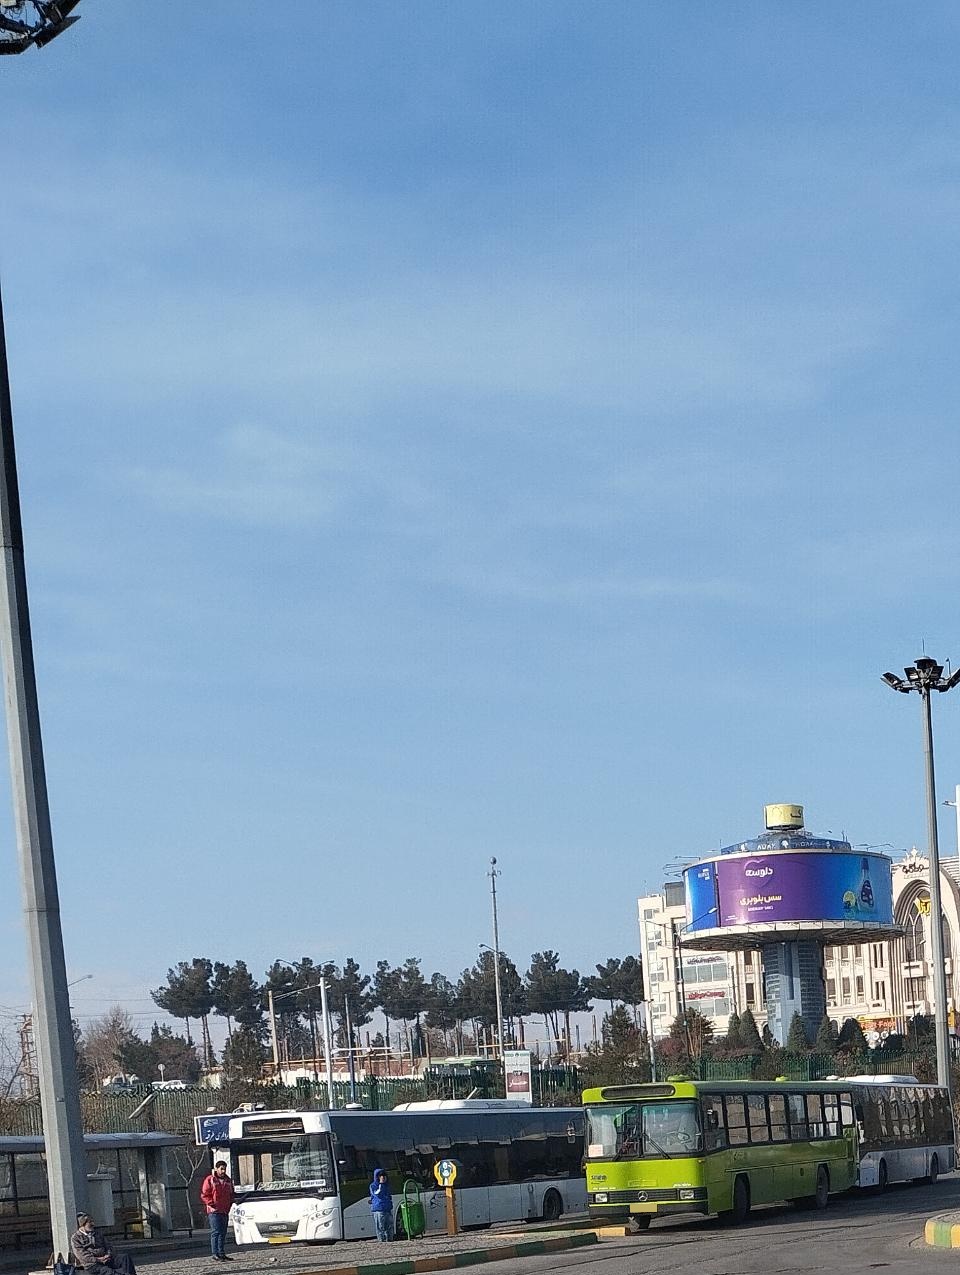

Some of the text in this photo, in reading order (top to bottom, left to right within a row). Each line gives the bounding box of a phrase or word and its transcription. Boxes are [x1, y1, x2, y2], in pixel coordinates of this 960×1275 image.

[745, 866, 773, 878] دلوسه
[740, 894, 782, 906] سس بلوبری
